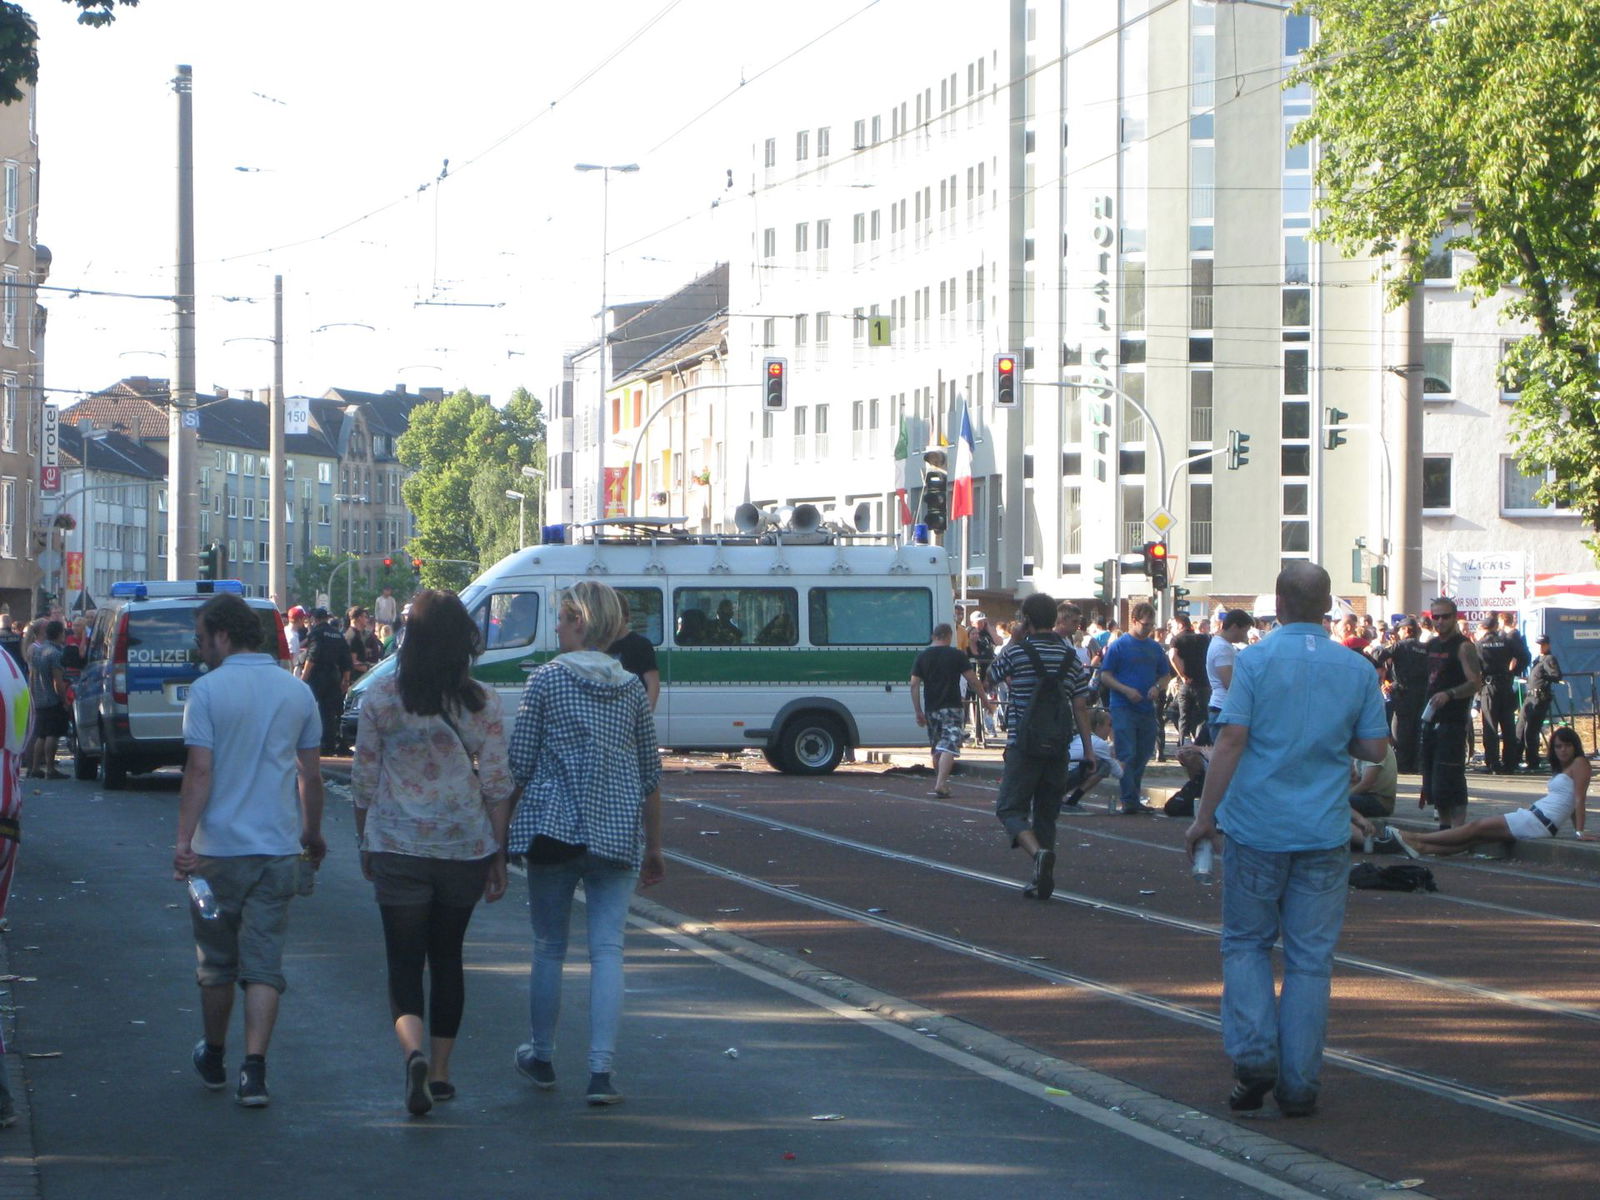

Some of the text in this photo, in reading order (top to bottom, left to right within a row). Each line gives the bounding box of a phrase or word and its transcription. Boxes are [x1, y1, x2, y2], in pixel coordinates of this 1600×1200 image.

[874, 321, 882, 341] 1
[1088, 194, 1114, 483] HOTEL CONTI
[287, 410, 306, 423] 150
[43, 404, 57, 489] ferrotel
[1465, 597, 1478, 607] SIND
[127, 649, 190, 662] POLIZEI
